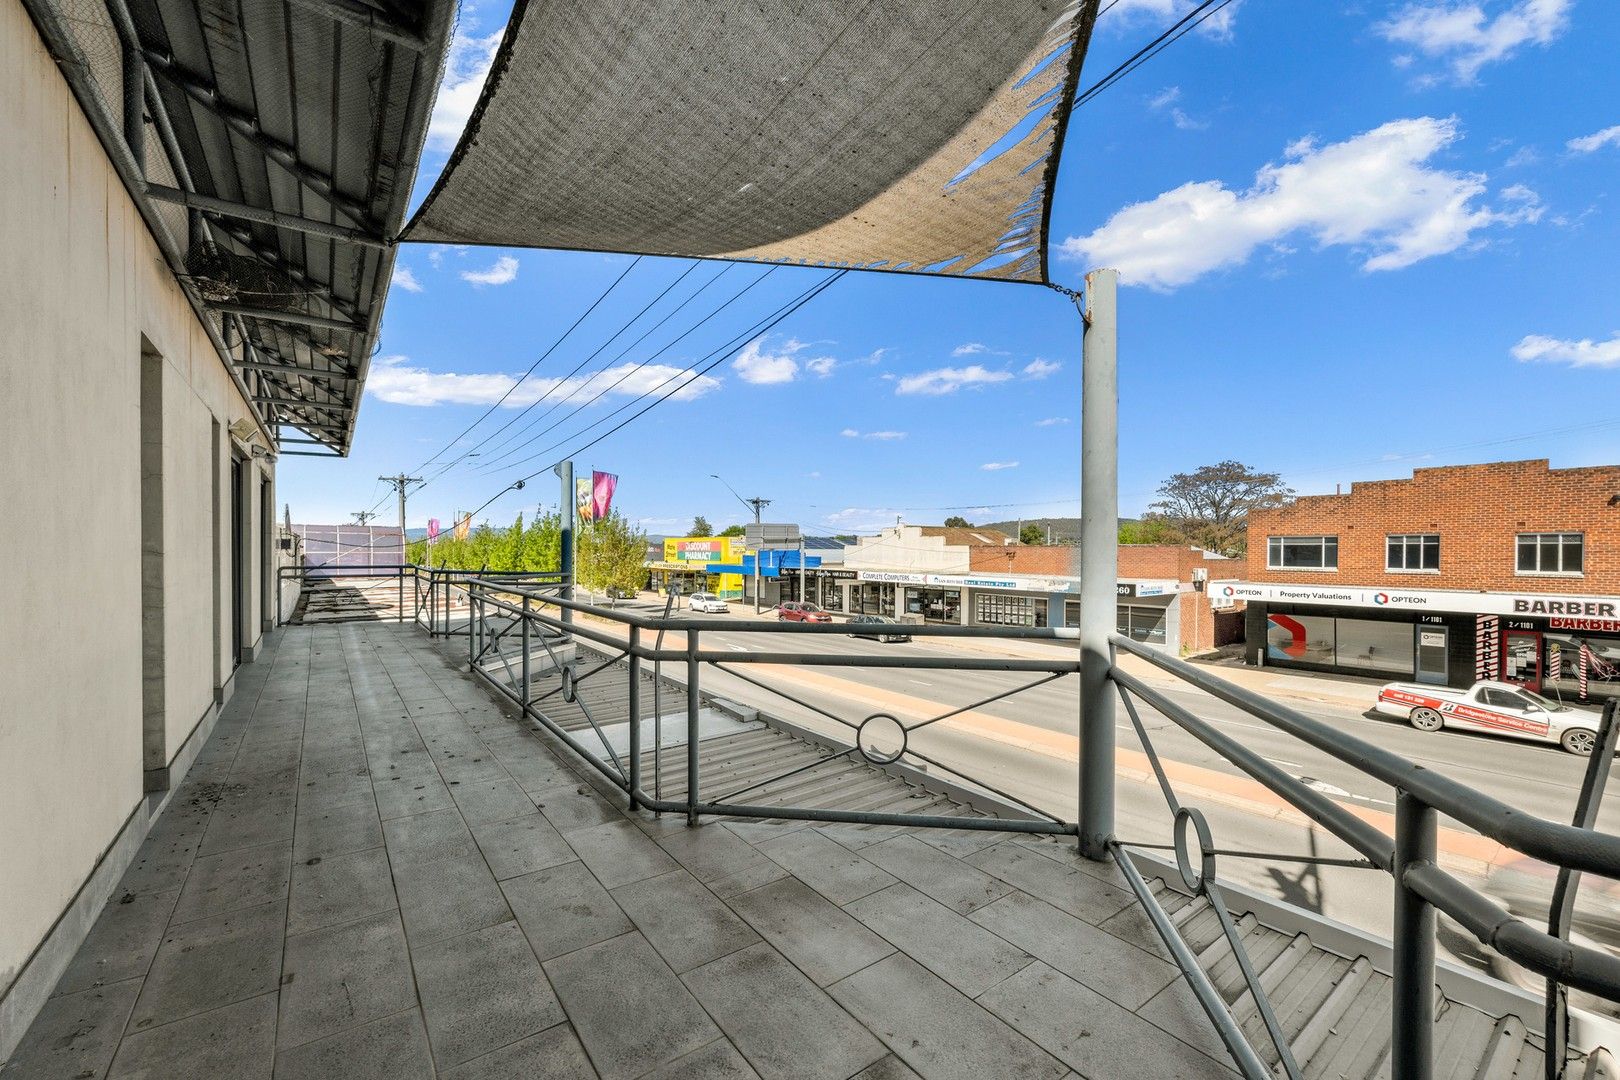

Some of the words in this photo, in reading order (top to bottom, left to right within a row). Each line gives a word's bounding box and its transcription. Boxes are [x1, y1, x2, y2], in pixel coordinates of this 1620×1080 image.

[685, 542, 711, 551] DISCOUNT
[684, 552, 712, 560] PHARMACY
[862, 572, 883, 581] COMPLETE
[883, 573, 910, 582] COMPUTERS
[1280, 590, 1311, 599] Property
[1312, 592, 1352, 601] Valuations
[1391, 596, 1427, 604] OPTEON
[1513, 599, 1617, 618] BARBER
[1482, 621, 1492, 681] BARBER
[1457, 708, 1497, 721] Bridgestone
[1498, 717, 1523, 727] Service
